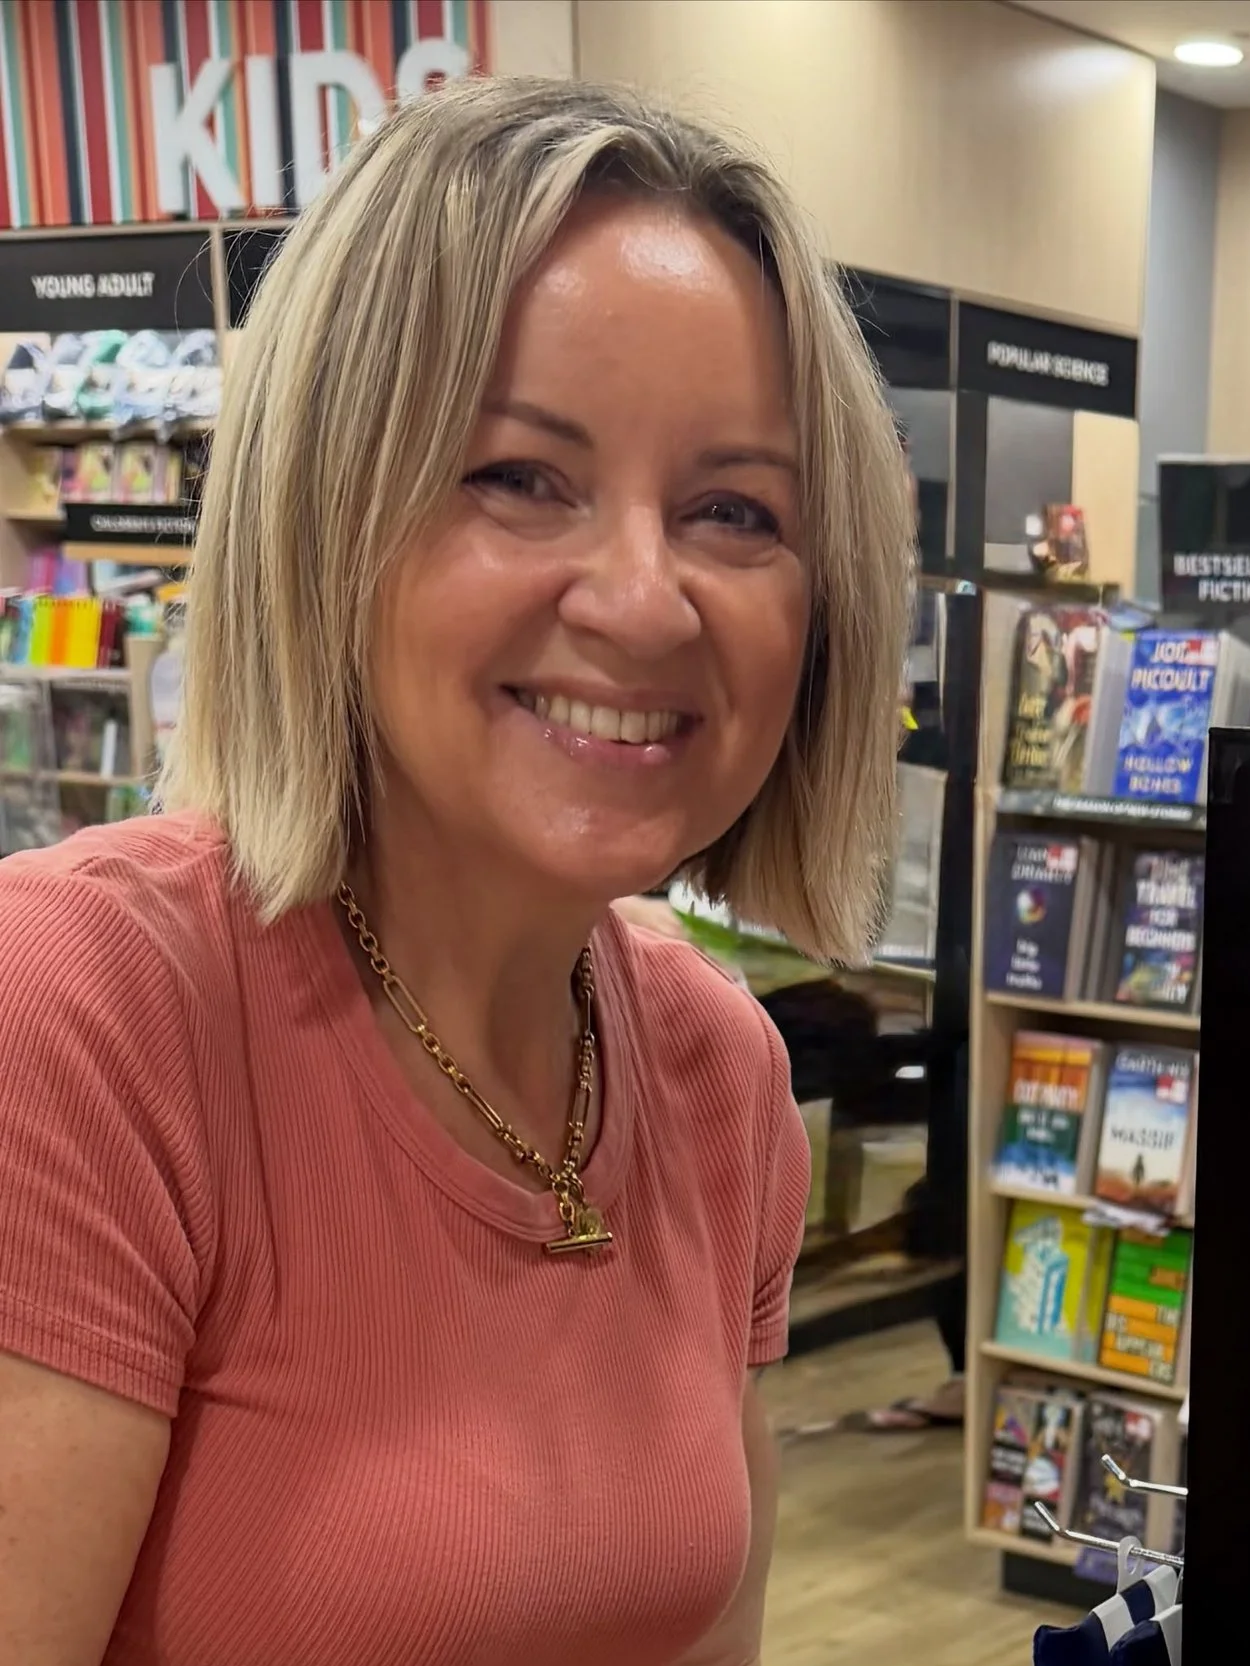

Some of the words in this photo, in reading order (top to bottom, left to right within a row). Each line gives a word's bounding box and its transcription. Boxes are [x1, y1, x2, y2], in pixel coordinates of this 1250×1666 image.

[31, 274, 95, 299] YOUNG
[97, 271, 155, 297] ADULT
[987, 341, 1053, 377] POPULAR
[1053, 354, 1110, 387] SCIENCE
